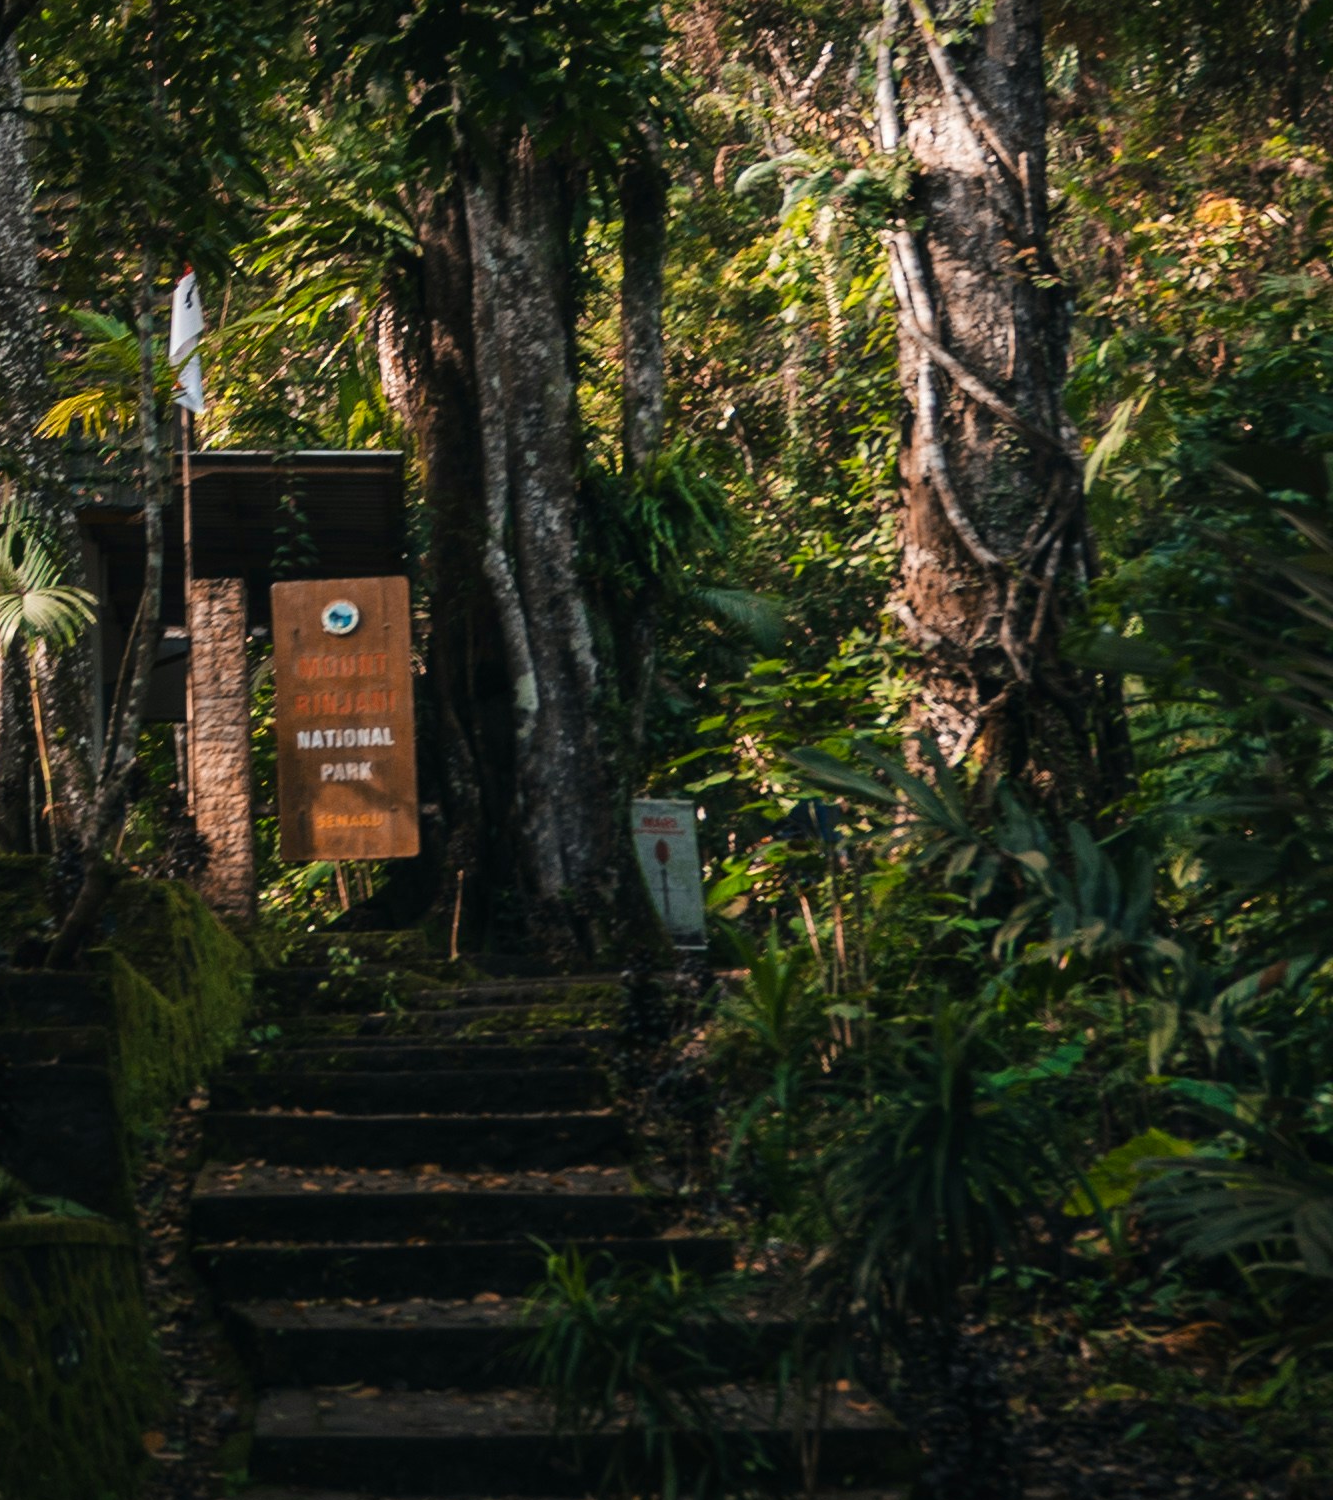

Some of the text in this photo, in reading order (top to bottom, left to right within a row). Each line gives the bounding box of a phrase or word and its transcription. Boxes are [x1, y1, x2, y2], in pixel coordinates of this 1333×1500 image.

[296, 653, 388, 679] MOUNT
[294, 690, 397, 716] RINJANI
[296, 727, 395, 749] NATIONAL
[320, 761, 374, 782] PARK
[314, 813, 383, 829] SENARU
